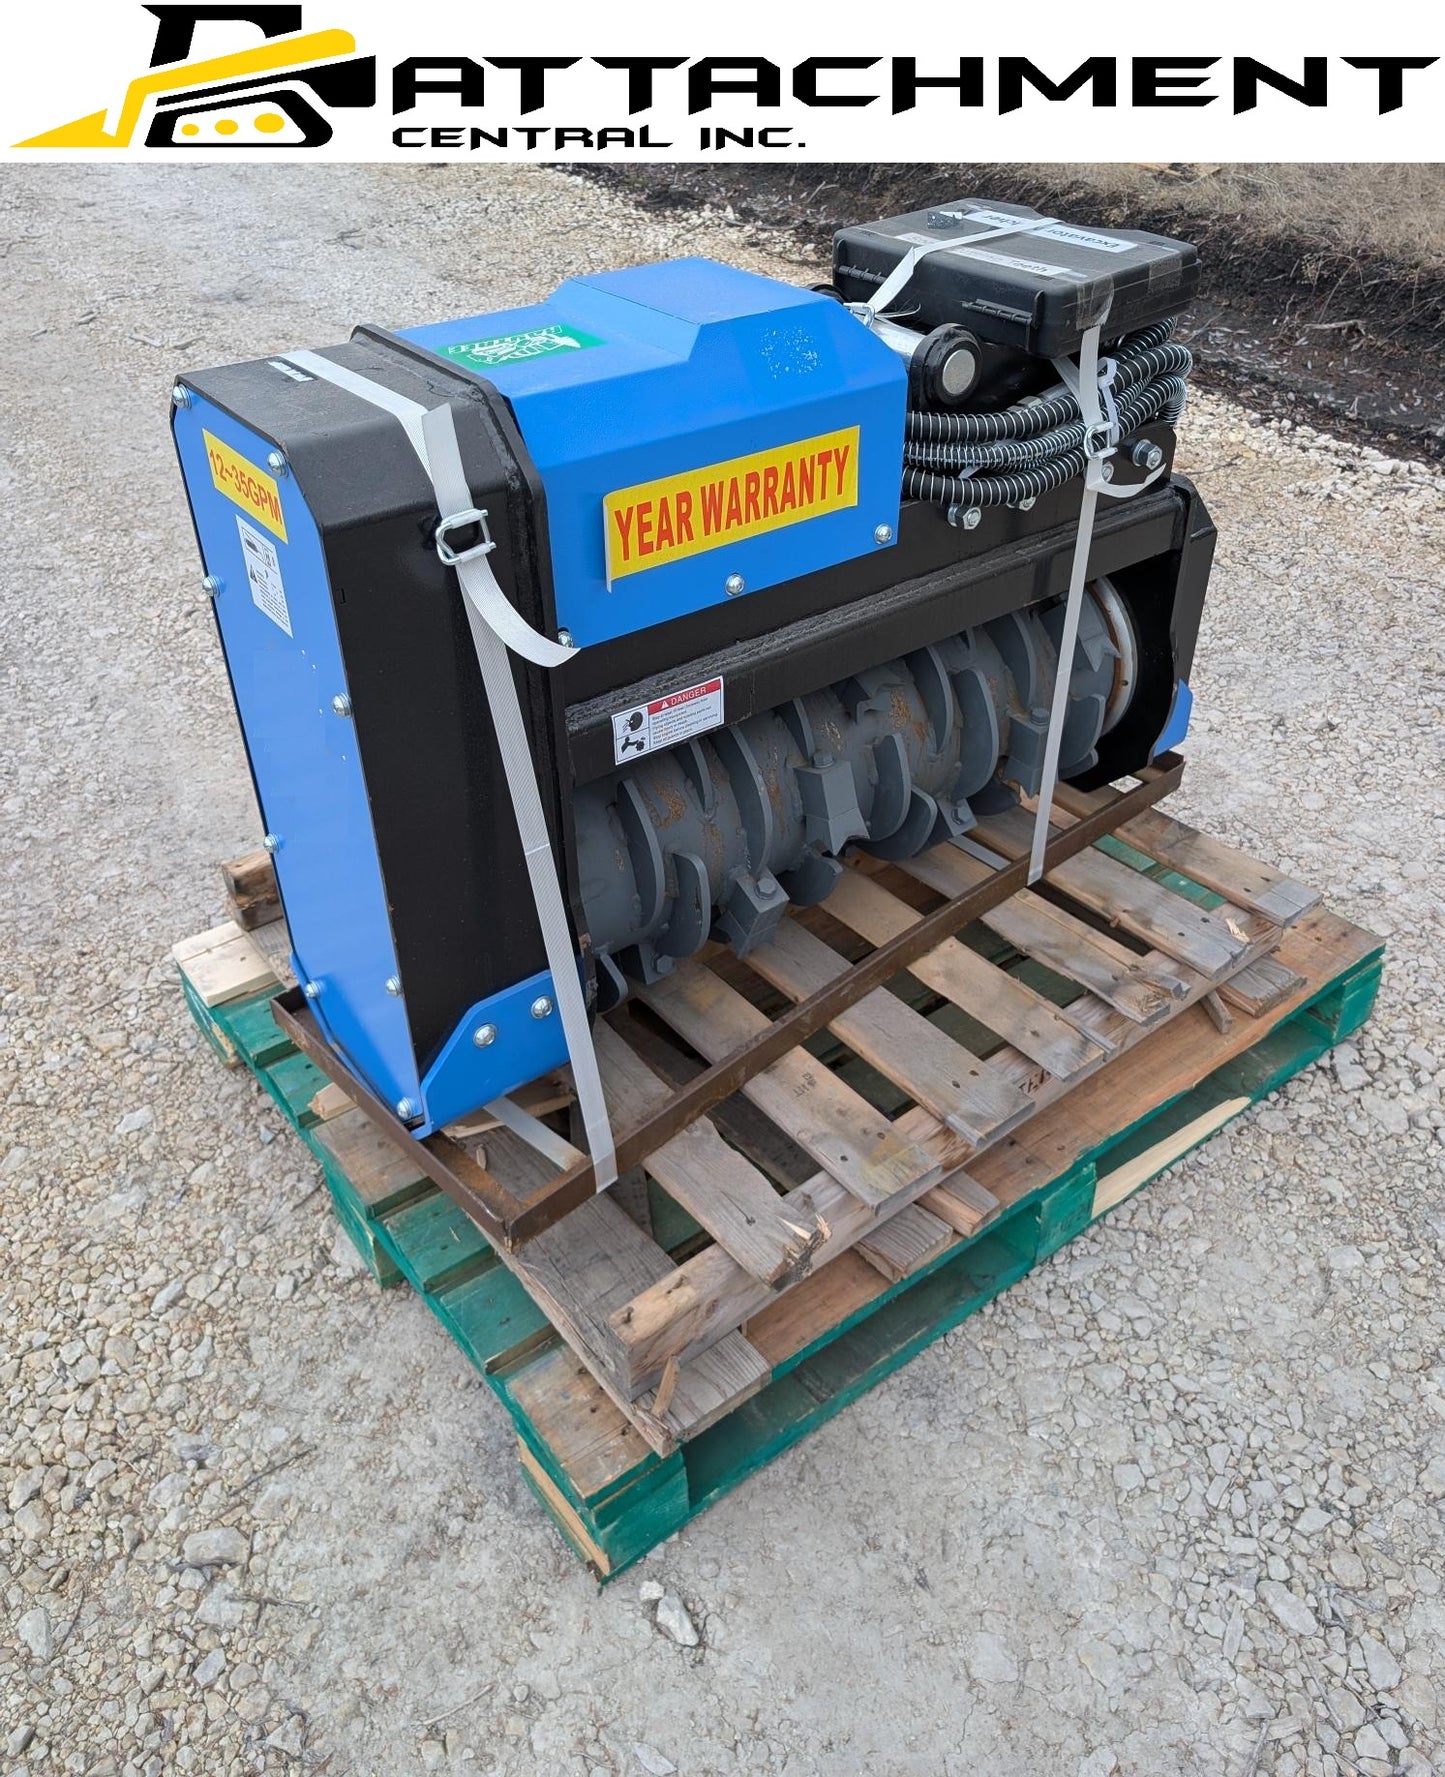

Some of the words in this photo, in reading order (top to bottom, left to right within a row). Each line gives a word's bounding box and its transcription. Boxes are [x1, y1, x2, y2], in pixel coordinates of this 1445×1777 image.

[1047, 229, 1121, 249] Excavator
[614, 491, 694, 561] YEAR
[700, 445, 850, 537] WARRANTY
[671, 686, 707, 706] DANGER
